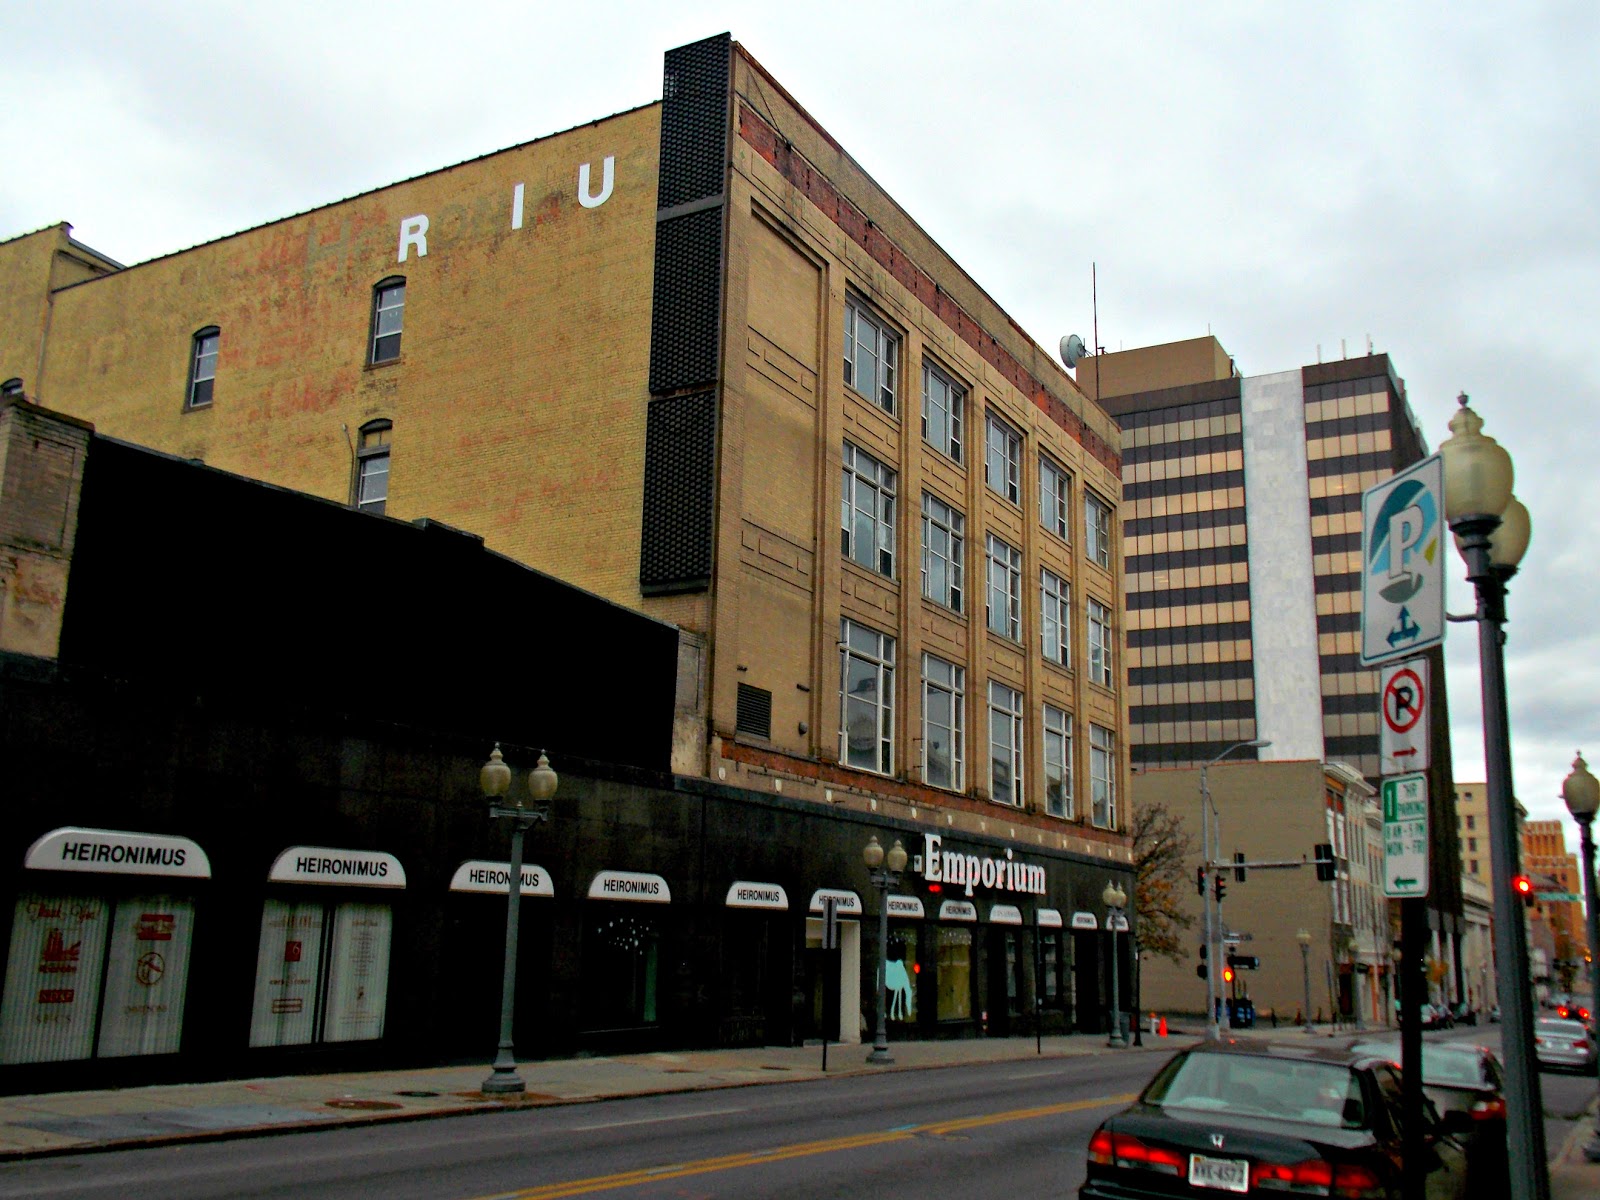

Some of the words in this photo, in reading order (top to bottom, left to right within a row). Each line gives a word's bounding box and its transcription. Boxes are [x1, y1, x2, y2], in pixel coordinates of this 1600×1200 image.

[1389, 504, 1425, 580] P
[62, 842, 186, 866] HEIRONIMUS
[296, 857, 388, 877] HEIRONIMUS
[924, 833, 1046, 897] Emporium
[469, 869, 539, 887] HEIRONMUS
[603, 879, 659, 895] HEIRONIMUS
[737, 889, 780, 902] HEIRONIMUS
[887, 901, 919, 912] HEIRONIMUS
